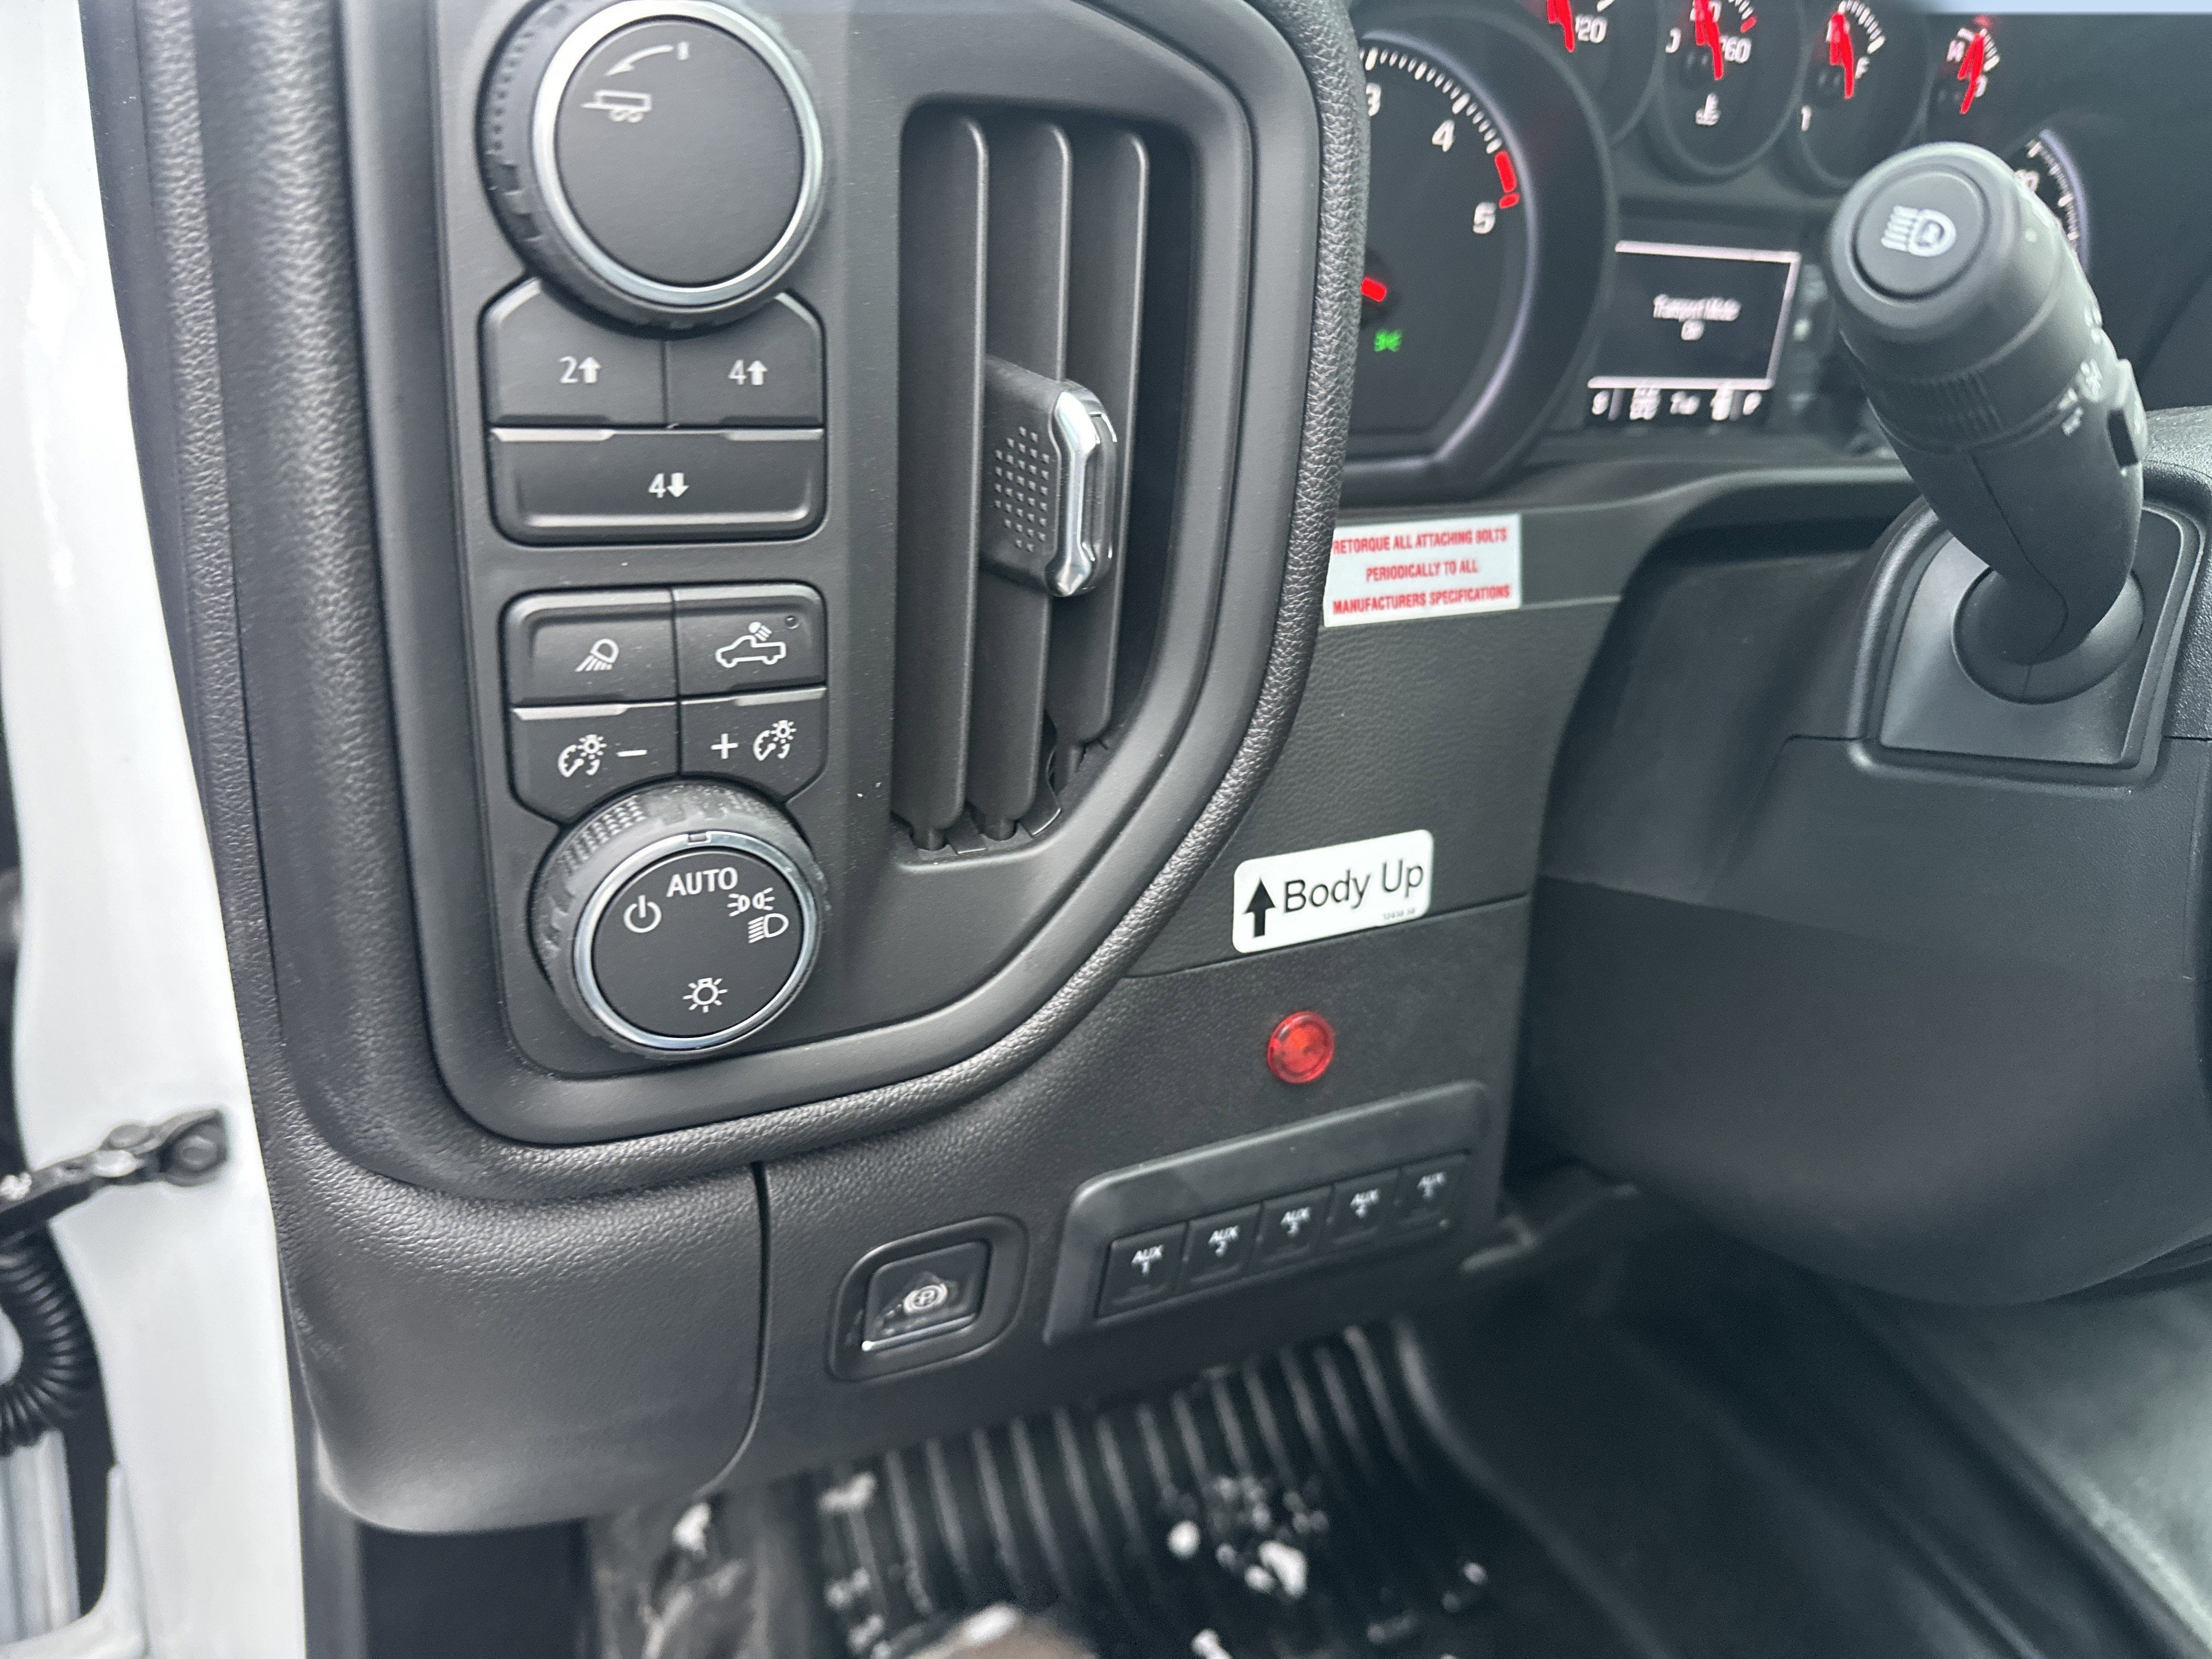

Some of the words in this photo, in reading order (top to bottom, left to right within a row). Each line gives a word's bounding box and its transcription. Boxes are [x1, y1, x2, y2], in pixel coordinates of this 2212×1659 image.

[1365, 83, 1381, 117] 3
[1431, 119, 1455, 152] 4
[1472, 201, 1497, 234] 5
[559, 356, 578, 383] 2
[728, 360, 747, 385] 4
[648, 473, 667, 498] 4
[1333, 536, 1390, 555] RETORQUE
[1393, 534, 1413, 550] ALL
[1415, 529, 1472, 548] ATTACHING
[1475, 527, 1508, 544] BOLTS
[1366, 562, 1441, 583] PERIODICALLY
[1443, 560, 1457, 575] TO
[1459, 558, 1479, 574] ALL
[1332, 591, 1426, 615] MANUFACTURERS
[1429, 584, 1511, 606] SPECIFICATIONS
[665, 866, 738, 898] AUTO
[1283, 868, 1372, 913] Body
[1381, 858, 1425, 899] Up
[1131, 1245, 1164, 1264] AUX
